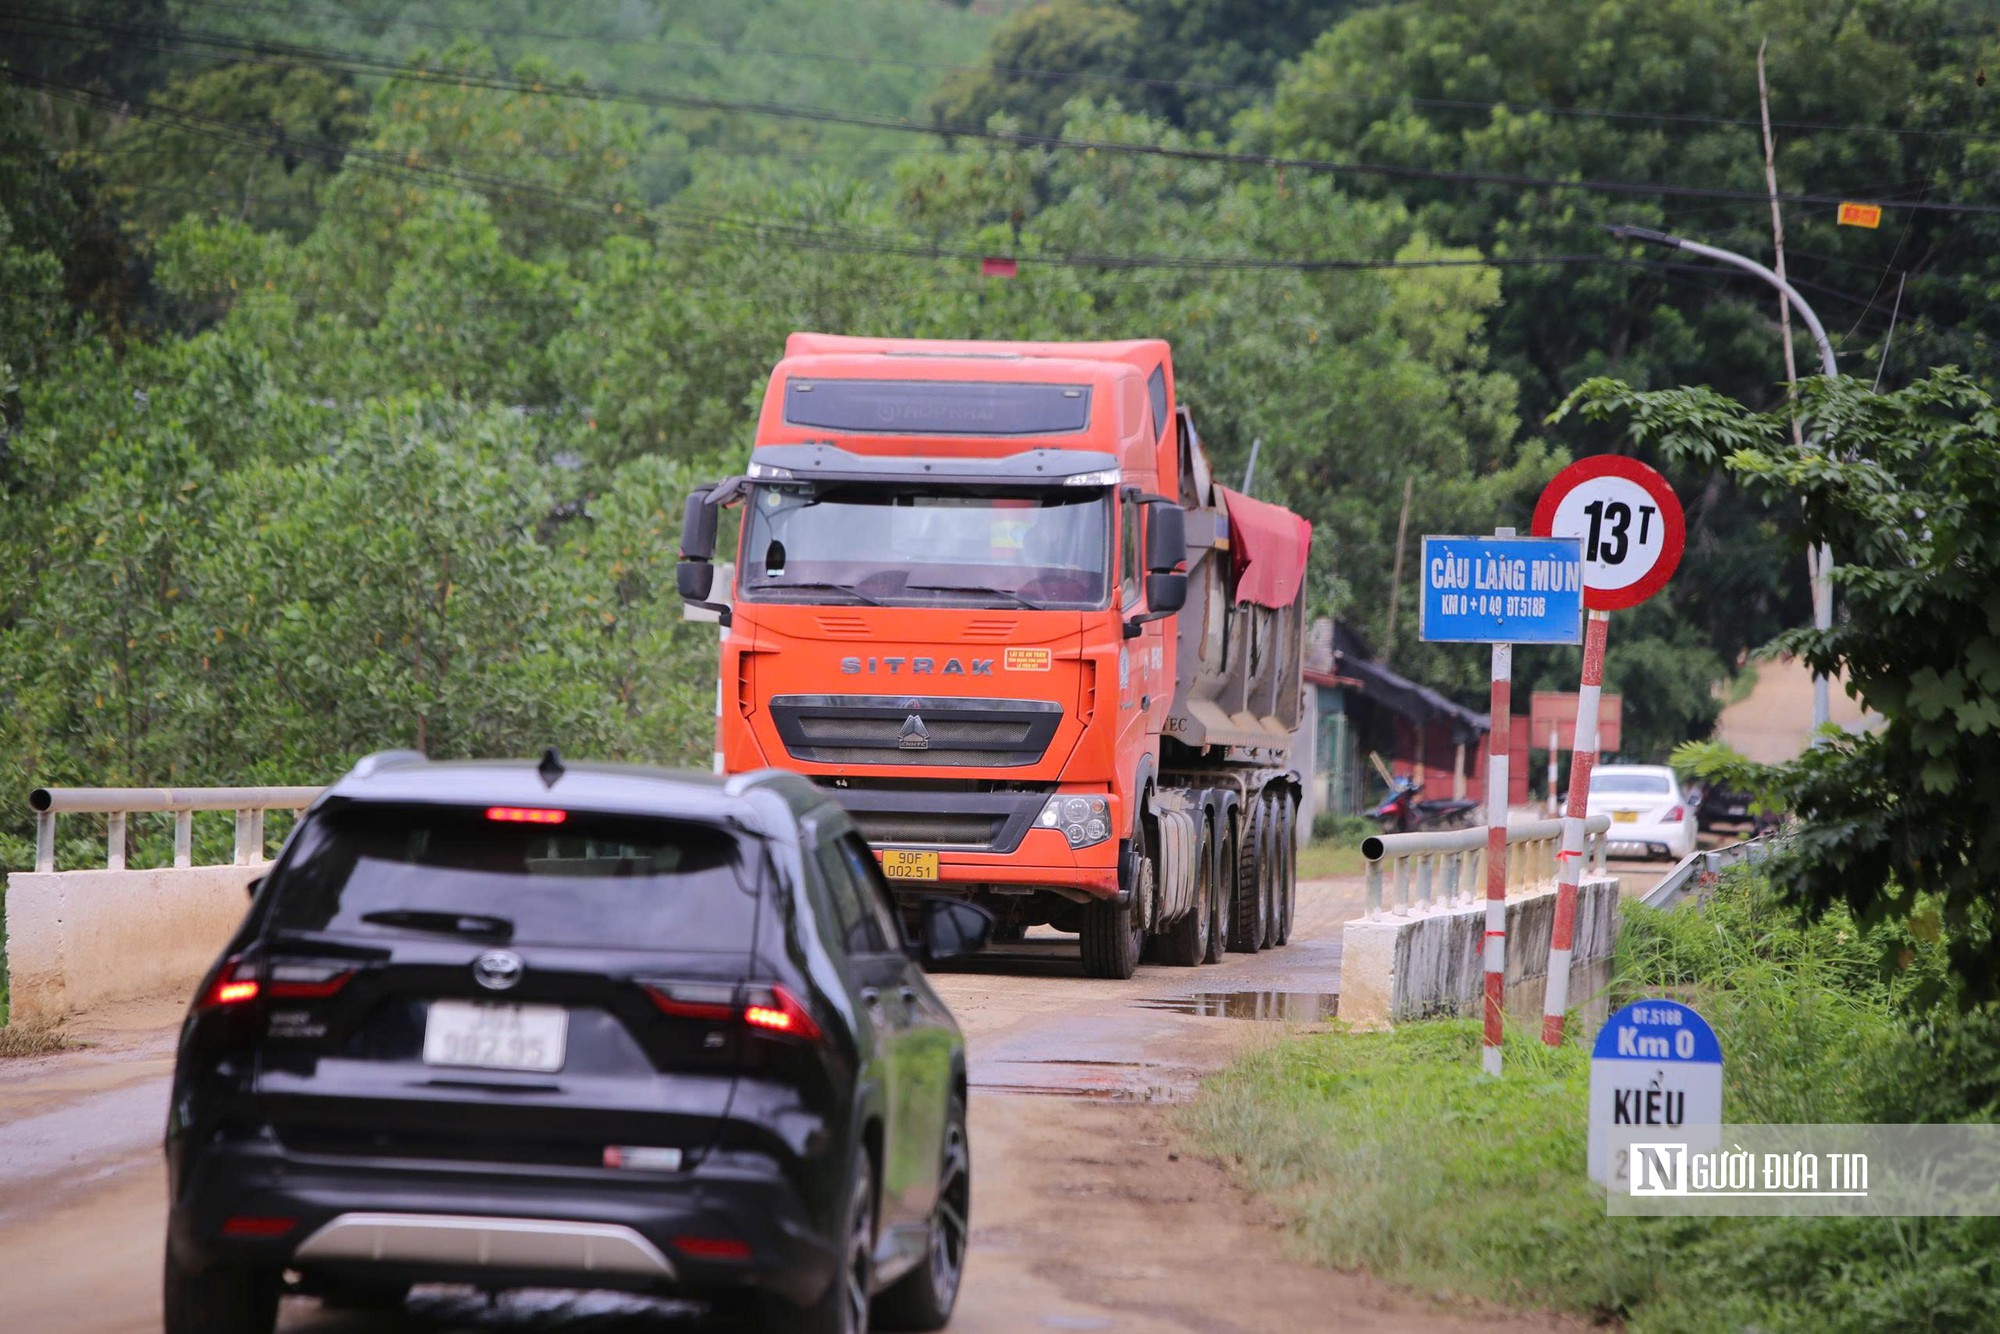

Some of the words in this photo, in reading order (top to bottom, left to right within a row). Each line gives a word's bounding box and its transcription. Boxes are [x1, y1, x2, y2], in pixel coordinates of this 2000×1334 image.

[1431, 545, 1470, 590] CẦU
[1475, 551, 1525, 591] LÀNG
[1531, 553, 1580, 593] MÙN
[841, 656, 994, 676] SITRAK
[899, 852, 922, 864] 90F
[888, 865, 930, 878] 002.51
[1618, 1026, 1670, 1058] Km
[1676, 1029, 1695, 1059] 0
